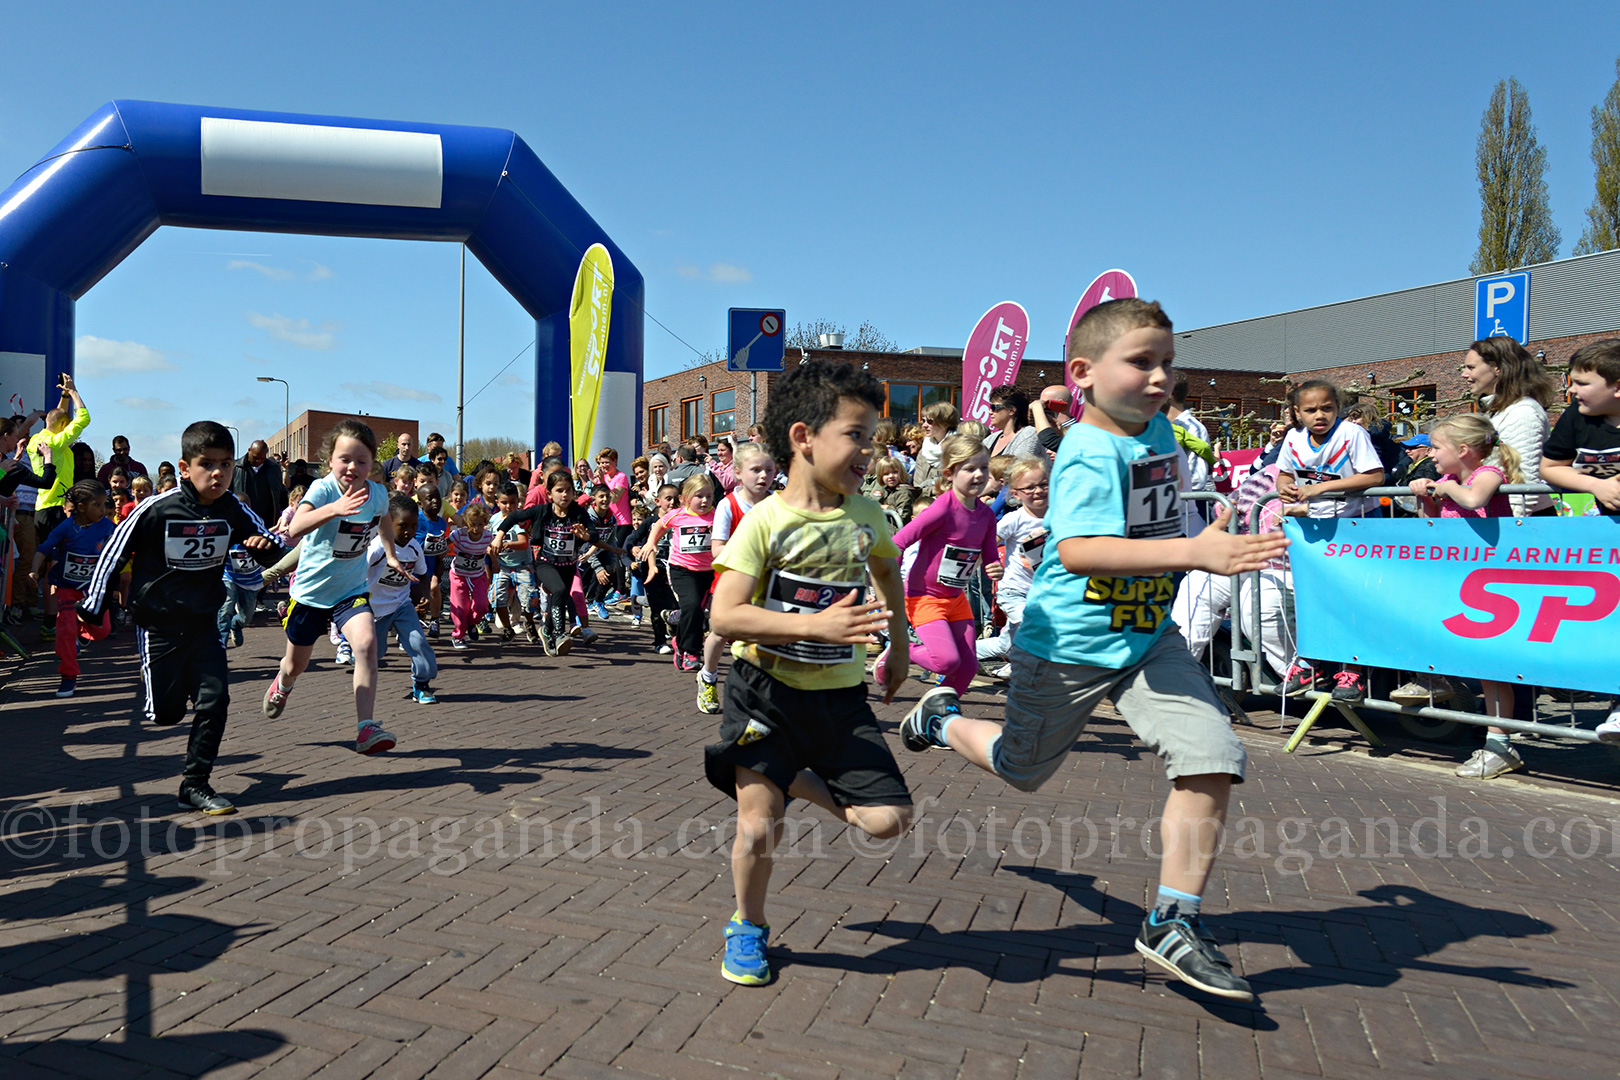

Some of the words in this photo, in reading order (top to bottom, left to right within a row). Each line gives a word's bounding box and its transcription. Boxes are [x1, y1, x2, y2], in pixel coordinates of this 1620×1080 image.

[1486, 281, 1516, 319] P
[972, 316, 1015, 424] SPORT
[1142, 484, 1180, 522] 12
[183, 538, 216, 559] 25
[550, 540, 567, 550] 89
[688, 534, 706, 546] 47
[1323, 543, 1497, 562] SPORTBEDRIJF
[463, 559, 478, 569] 36
[1109, 604, 1168, 634] FLY
